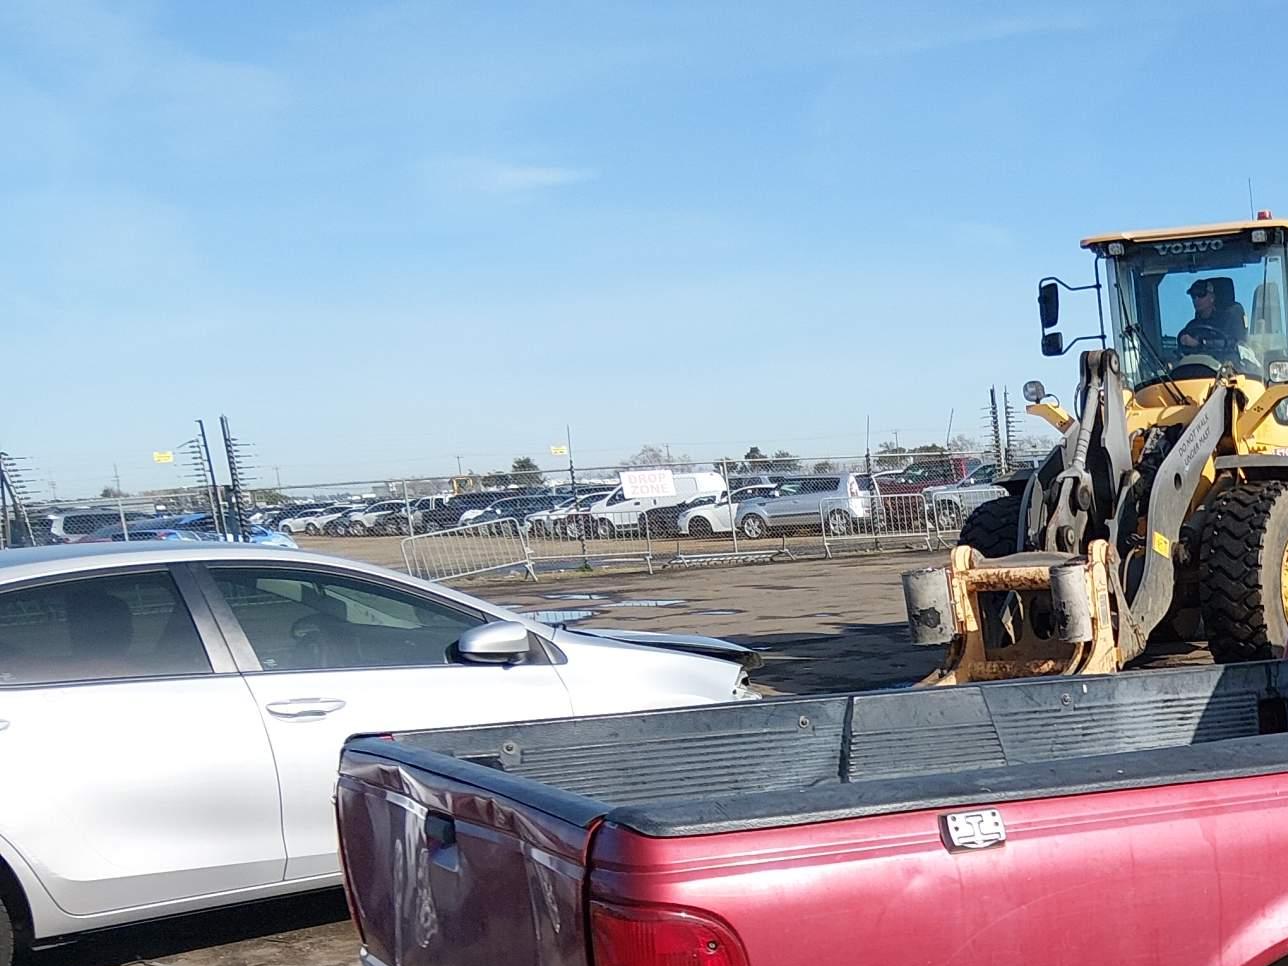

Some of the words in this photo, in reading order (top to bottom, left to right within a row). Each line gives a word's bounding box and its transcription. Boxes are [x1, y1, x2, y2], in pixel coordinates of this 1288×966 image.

[1153, 239, 1224, 256] VOLVO
[1184, 442, 1200, 466] UNDER
[627, 473, 666, 485] DROP
[630, 483, 669, 496] ZONE
